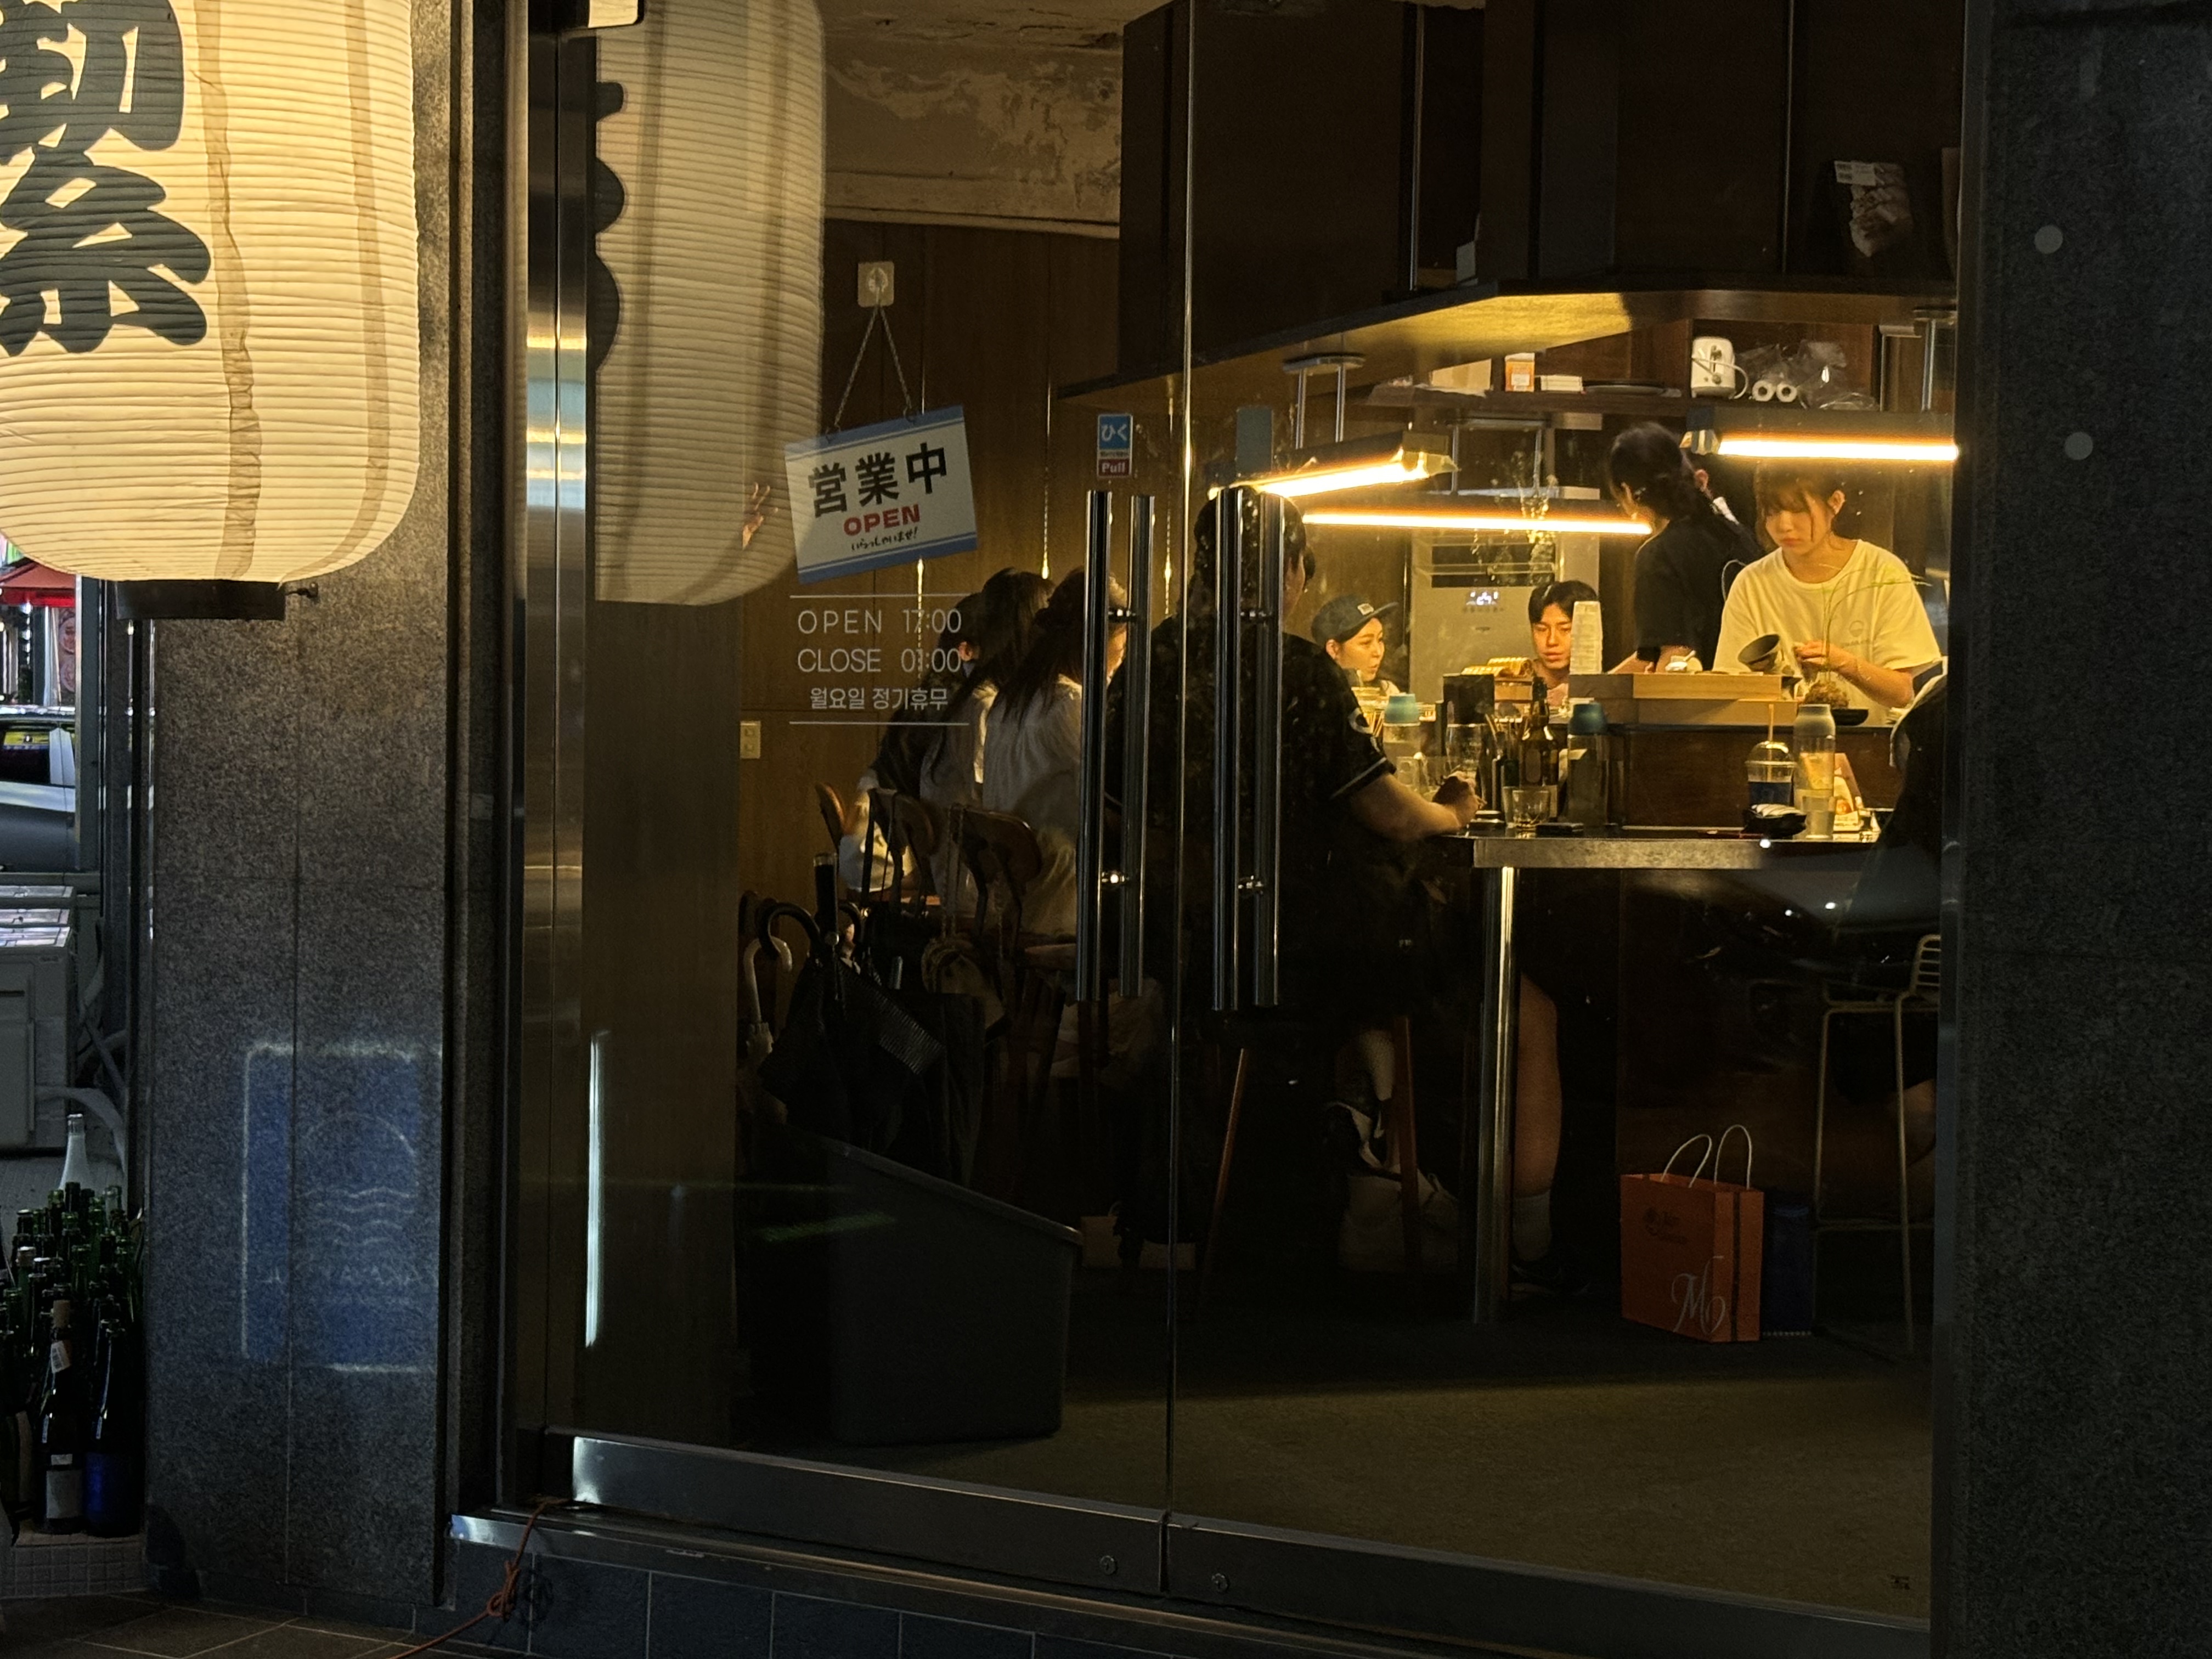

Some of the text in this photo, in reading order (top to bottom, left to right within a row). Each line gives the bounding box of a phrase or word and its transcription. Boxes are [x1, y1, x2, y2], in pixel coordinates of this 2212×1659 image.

[808, 442, 947, 517] 営業中
[1102, 462, 1126, 473] Pull
[844, 504, 921, 536] OPEN
[798, 608, 962, 634] OPEN 17:00
[798, 648, 962, 673] CLOSE 01:00
[810, 687, 948, 710] 월요일 정기휴무
